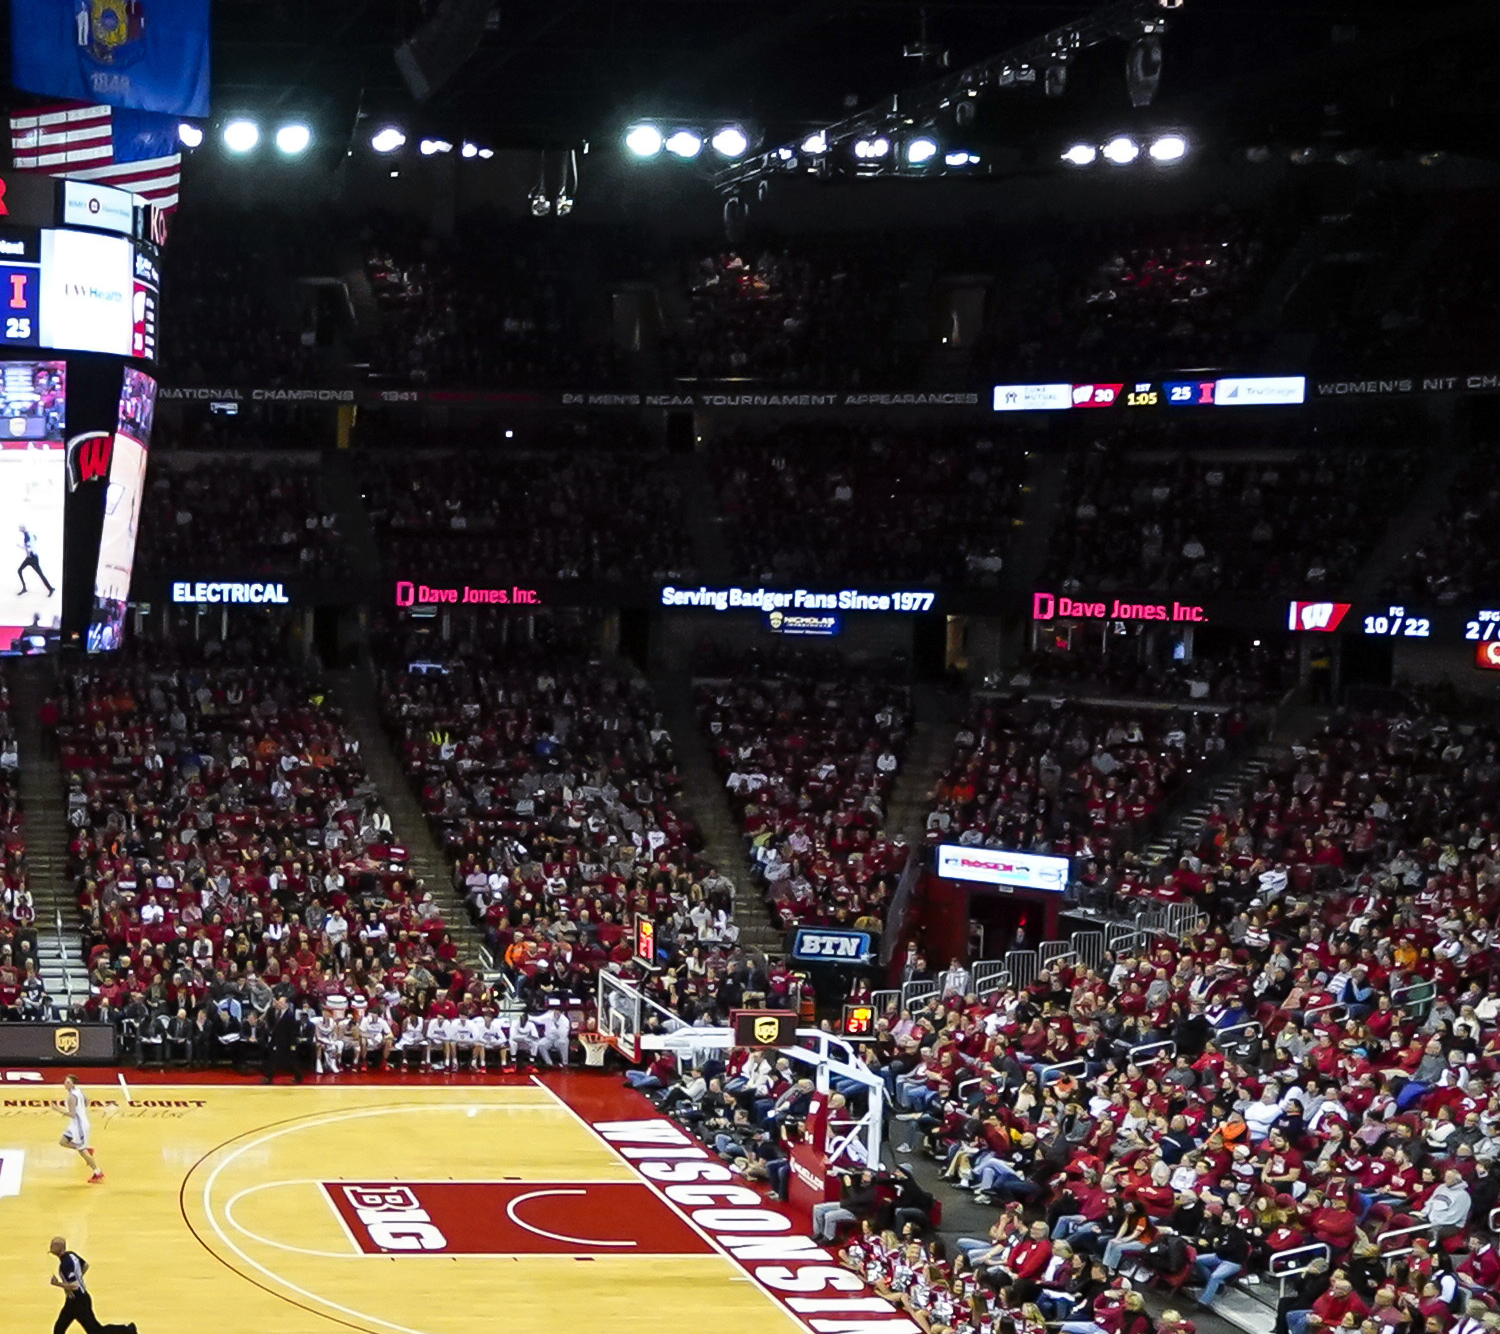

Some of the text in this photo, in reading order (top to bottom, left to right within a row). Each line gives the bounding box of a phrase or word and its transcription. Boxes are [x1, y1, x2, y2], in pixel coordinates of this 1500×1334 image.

[5, 318, 31, 339] 25
[1318, 378, 1412, 396] WOMEN'S
[1422, 376, 1457, 392] NIT
[158, 388, 355, 402] NATIONAL CHAMPIONS
[380, 391, 418, 402] 1941
[562, 393, 979, 406] 24 MEN'S NCAA TOURNAMENT APPEARANCES
[1094, 389, 1114, 402] 30
[1127, 393, 1158, 405] 1:05
[1171, 387, 1191, 400] 25
[173, 582, 289, 603] ELECTRICAL
[418, 585, 457, 603] Dave
[513, 586, 541, 604] Inc.
[662, 587, 935, 612] Serving Badger Fans Since 1977
[1059, 597, 1105, 618] Dave
[1173, 601, 1209, 622] Inc.
[1389, 607, 1404, 617] FG
[800, 935, 861, 957] BTN
[849, 1019, 867, 1033] 27
[59, 1036, 78, 1052] ups
[128, 1100, 207, 1108] COURT
